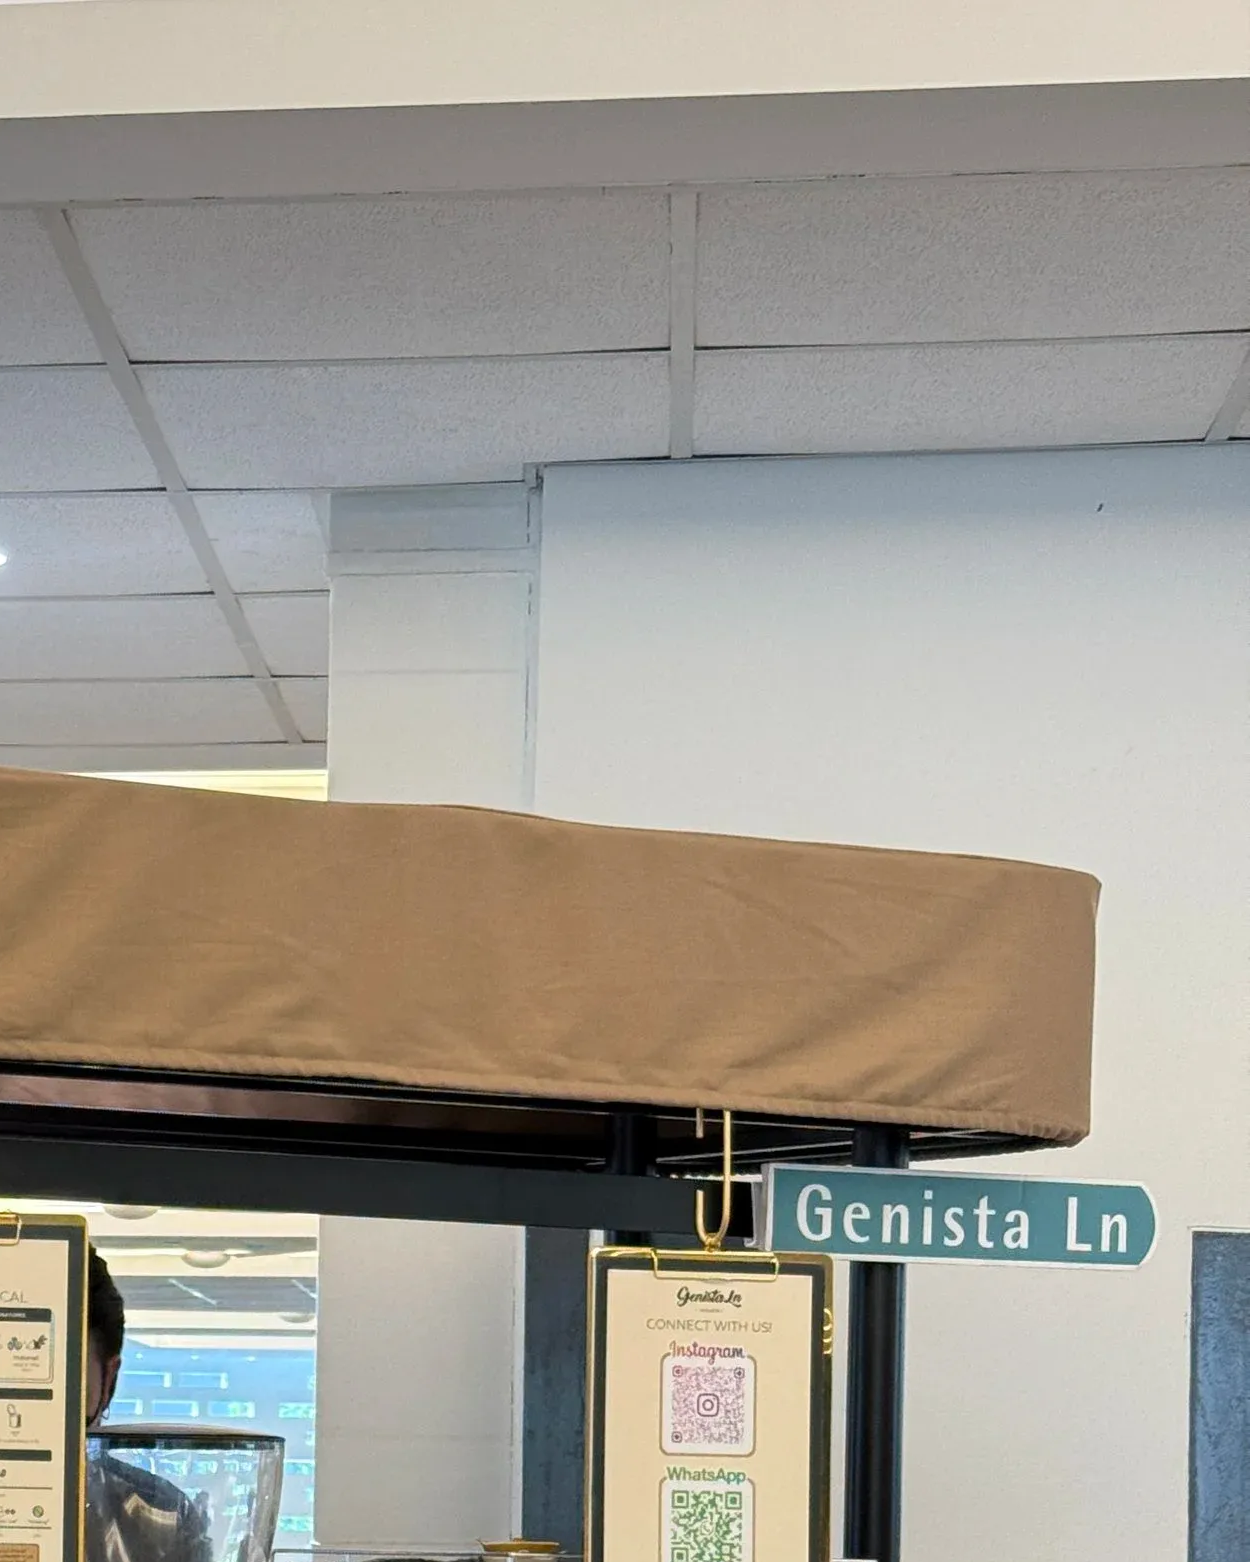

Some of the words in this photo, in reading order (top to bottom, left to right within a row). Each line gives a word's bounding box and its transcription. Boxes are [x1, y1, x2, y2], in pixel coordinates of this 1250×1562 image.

[795, 1182, 1030, 1251] Genista
[1065, 1195, 1129, 1254] Ln
[676, 1286, 724, 1307] Genista
[646, 1318, 711, 1332] CONNECT
[714, 1320, 749, 1332] WITH
[751, 1321, 773, 1333] US!
[669, 1340, 746, 1365] Instagram
[666, 1466, 746, 1485] WhatsApp
